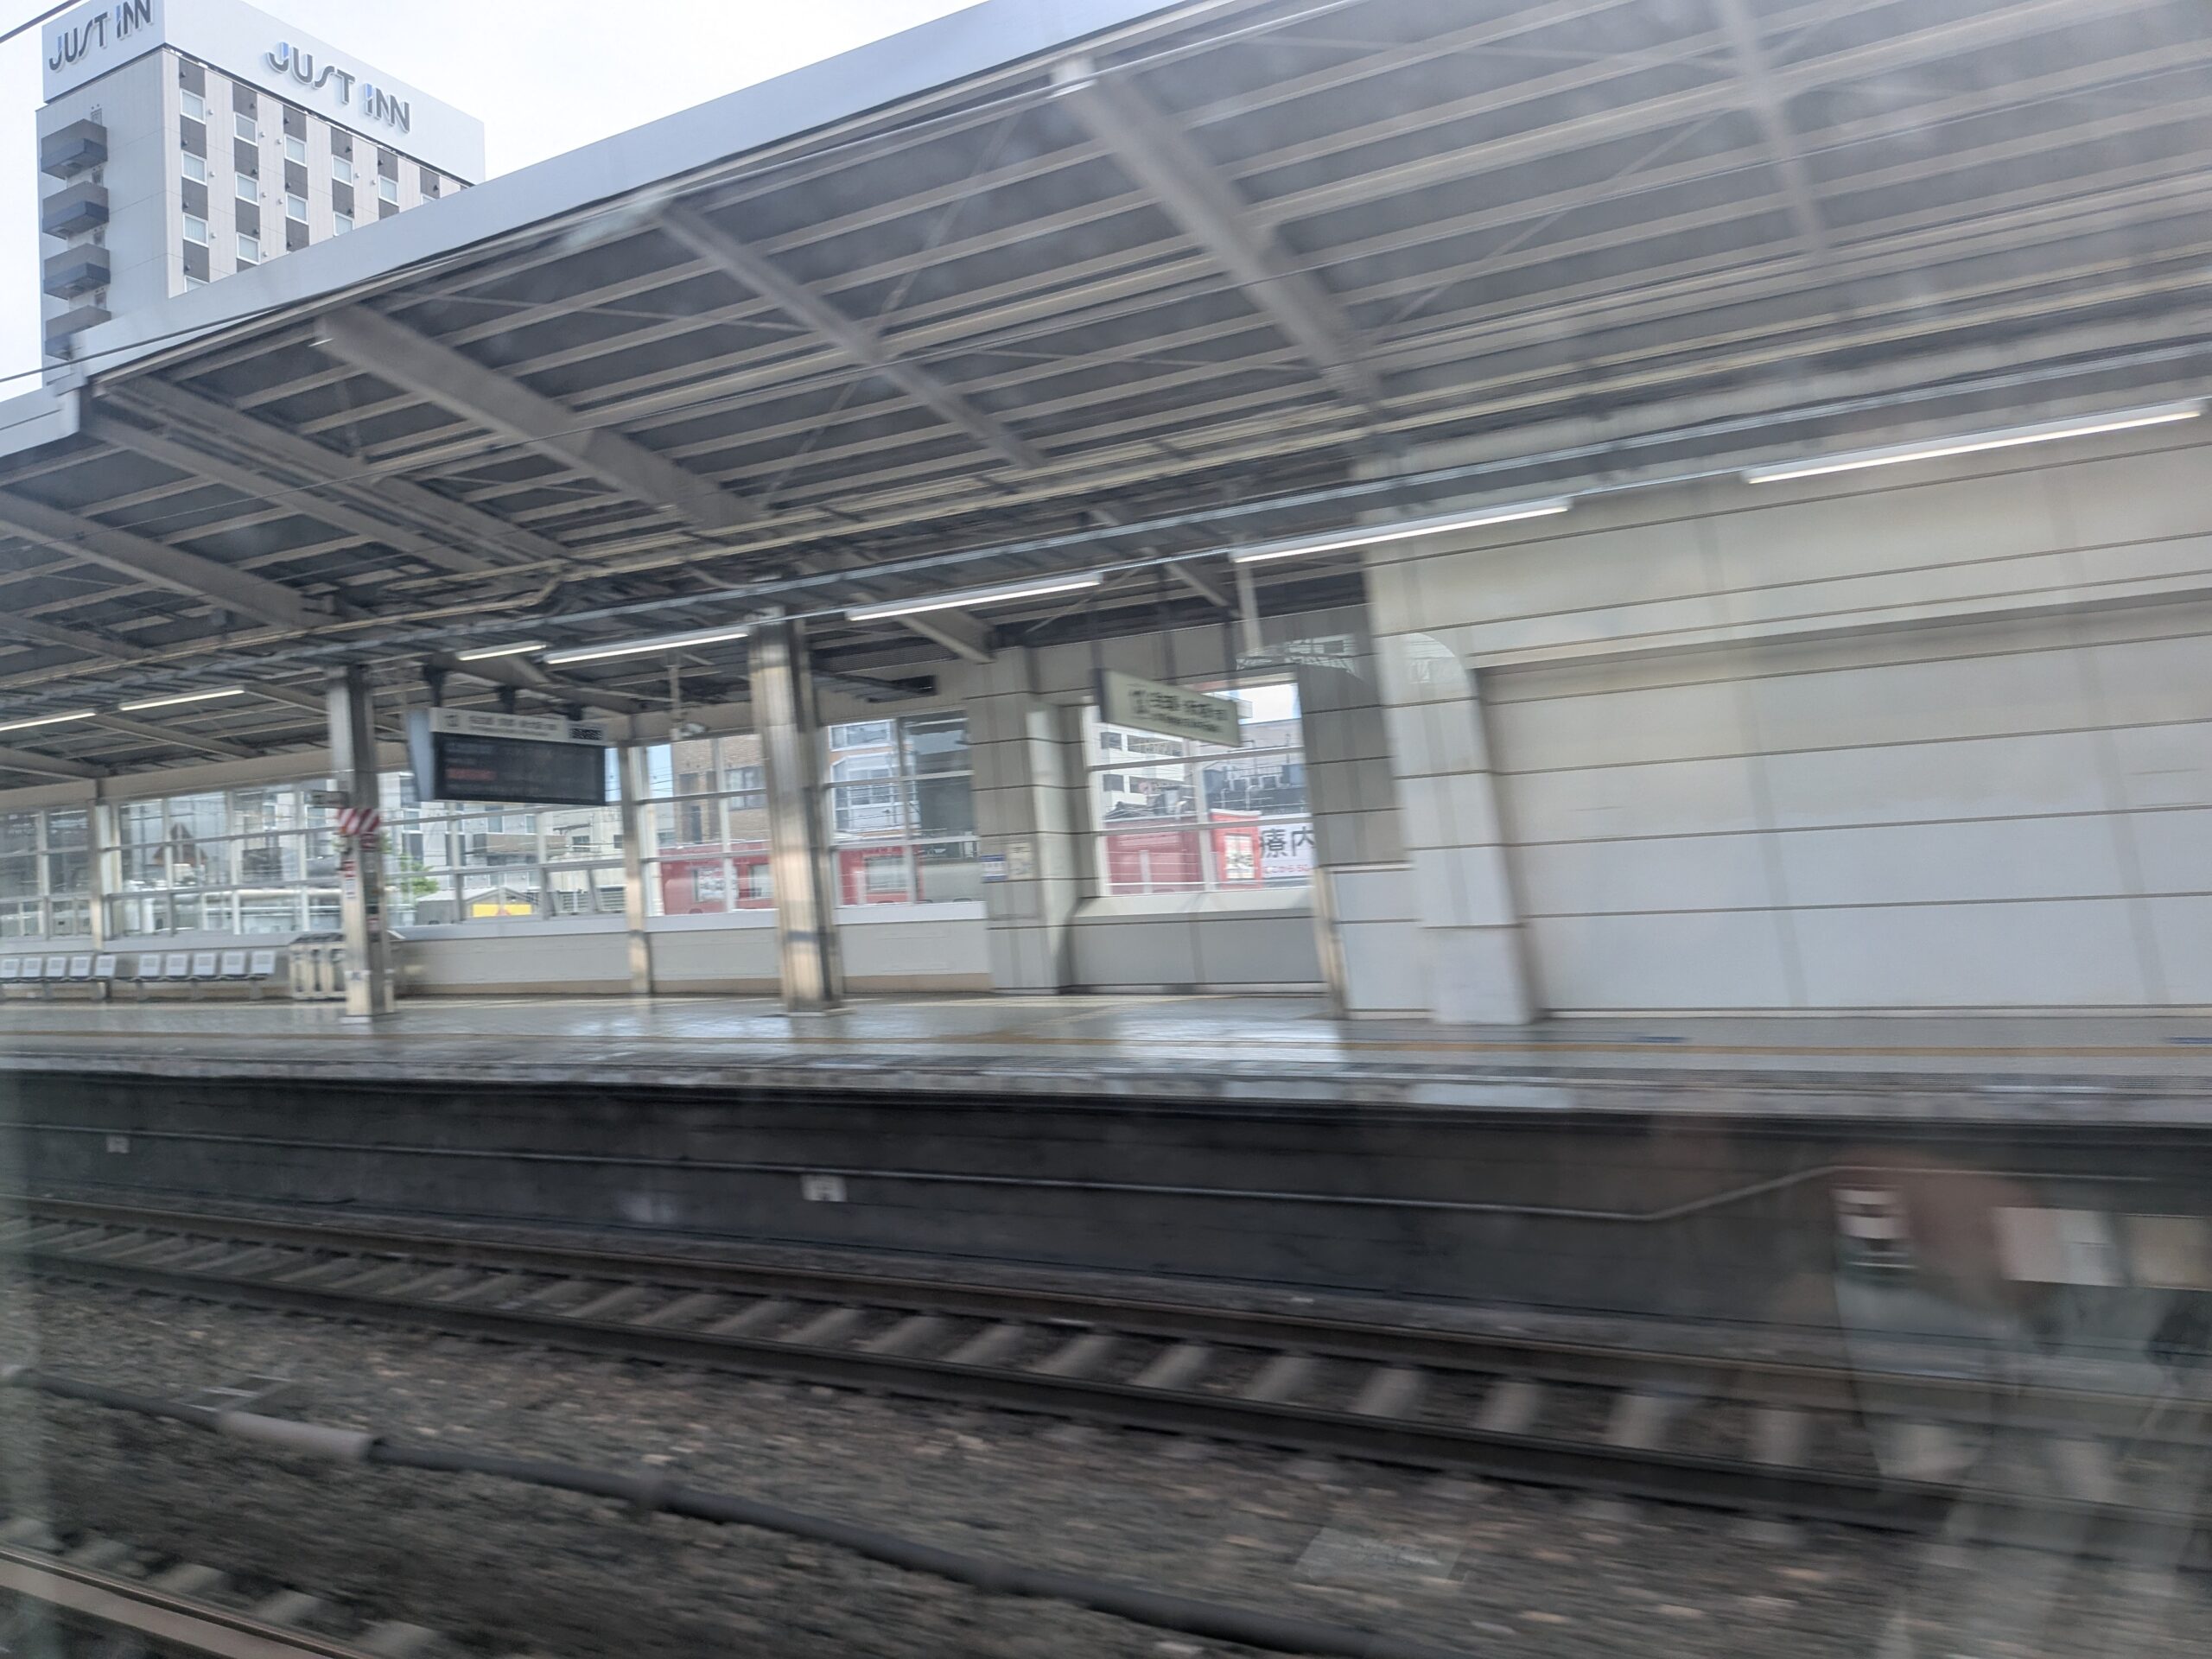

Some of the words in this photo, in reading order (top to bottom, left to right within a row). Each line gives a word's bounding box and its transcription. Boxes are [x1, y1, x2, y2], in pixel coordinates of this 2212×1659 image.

[48, 11, 108, 71] JUST
[266, 41, 355, 104] JUST
[363, 82, 410, 133] INN
